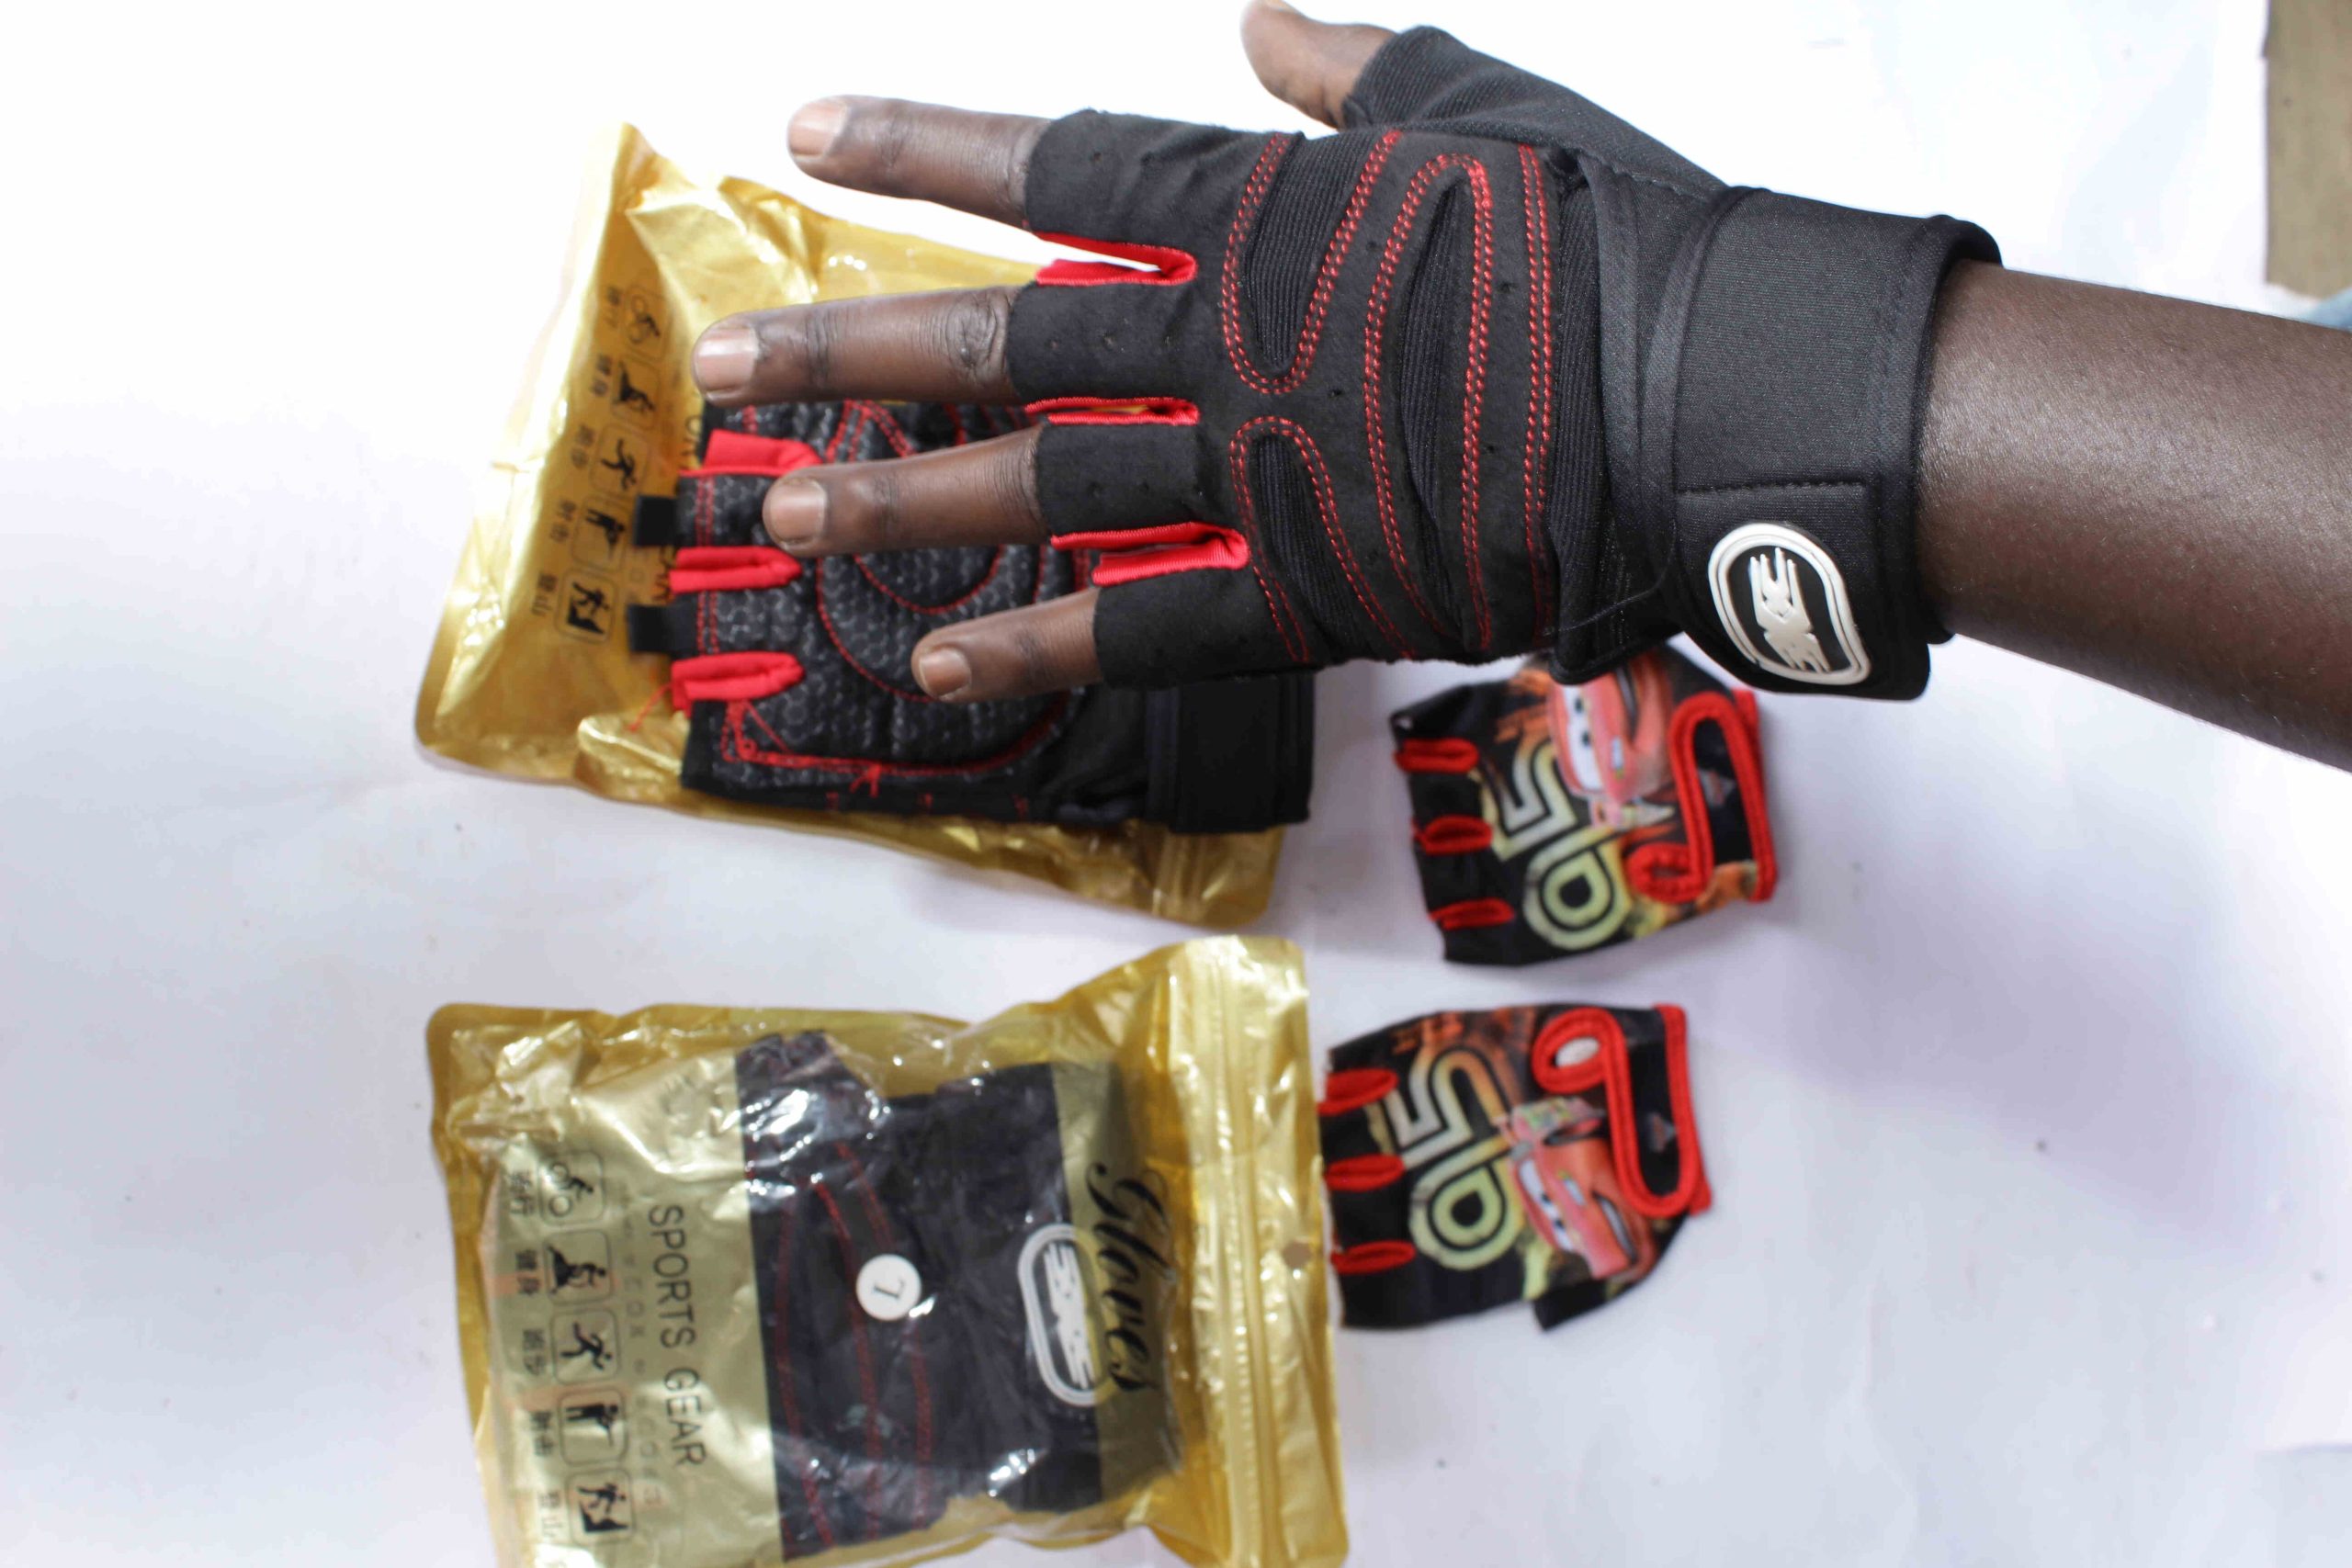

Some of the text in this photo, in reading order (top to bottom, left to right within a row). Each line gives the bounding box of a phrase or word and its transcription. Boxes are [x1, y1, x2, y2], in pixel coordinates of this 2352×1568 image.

[648, 1203, 707, 1468] SPORTS GEAR
[1086, 1161, 1173, 1392] Gloves
